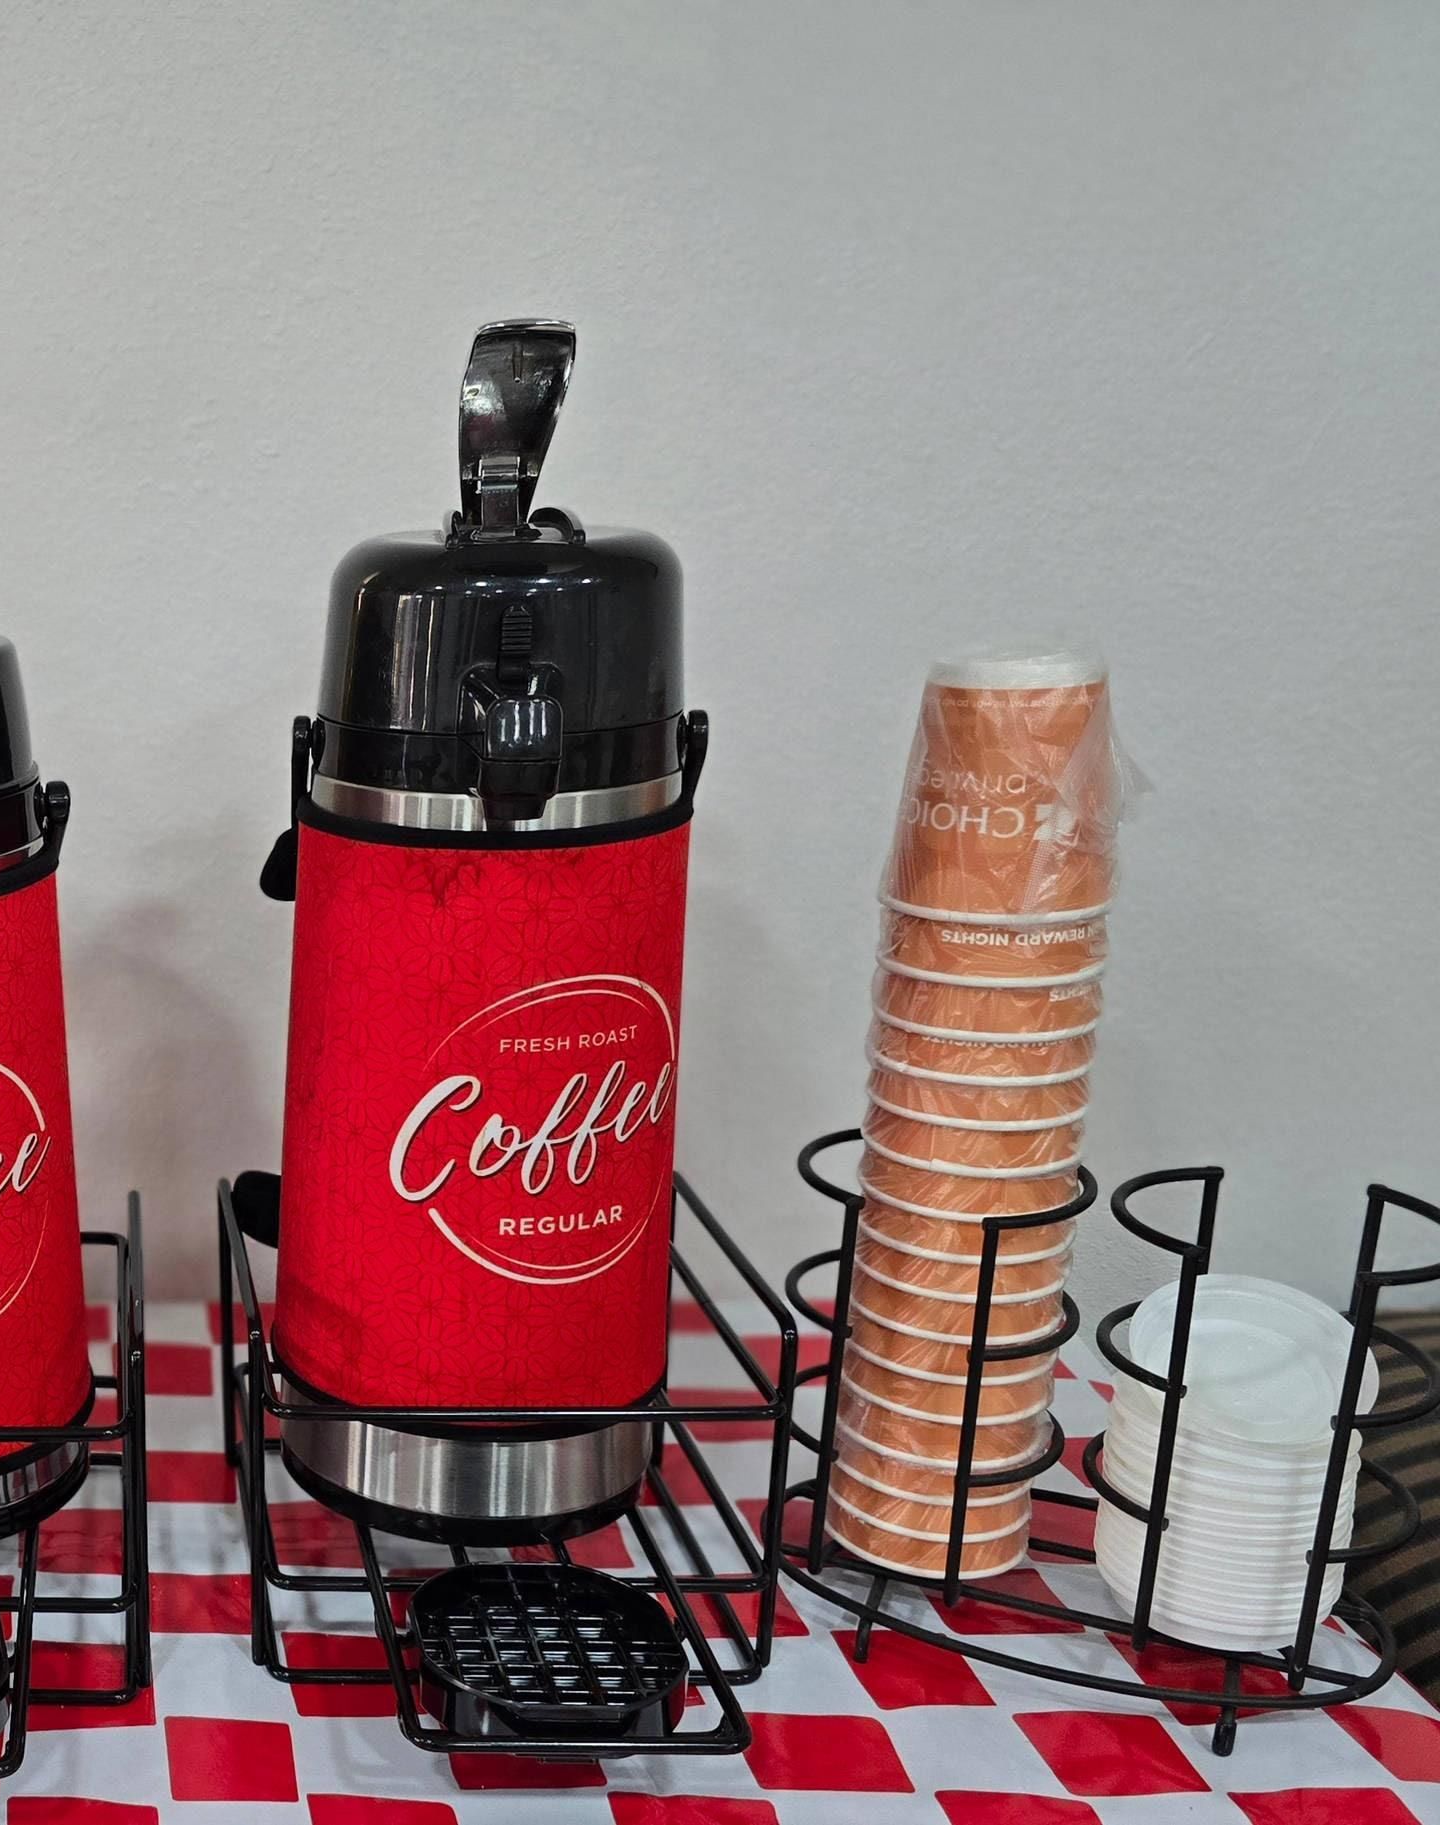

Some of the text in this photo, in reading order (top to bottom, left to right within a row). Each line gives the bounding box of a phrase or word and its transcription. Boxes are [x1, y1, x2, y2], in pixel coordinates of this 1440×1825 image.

[916, 758, 1027, 800] privileg
[904, 798, 1027, 839] CHOIC
[940, 929, 1010, 947] NIGHTS
[1015, 926, 1086, 946] REWARD
[499, 1025, 638, 1053] FRESH ROAST
[388, 1060, 675, 1202] Coffee
[499, 1205, 623, 1236] REGULAR
